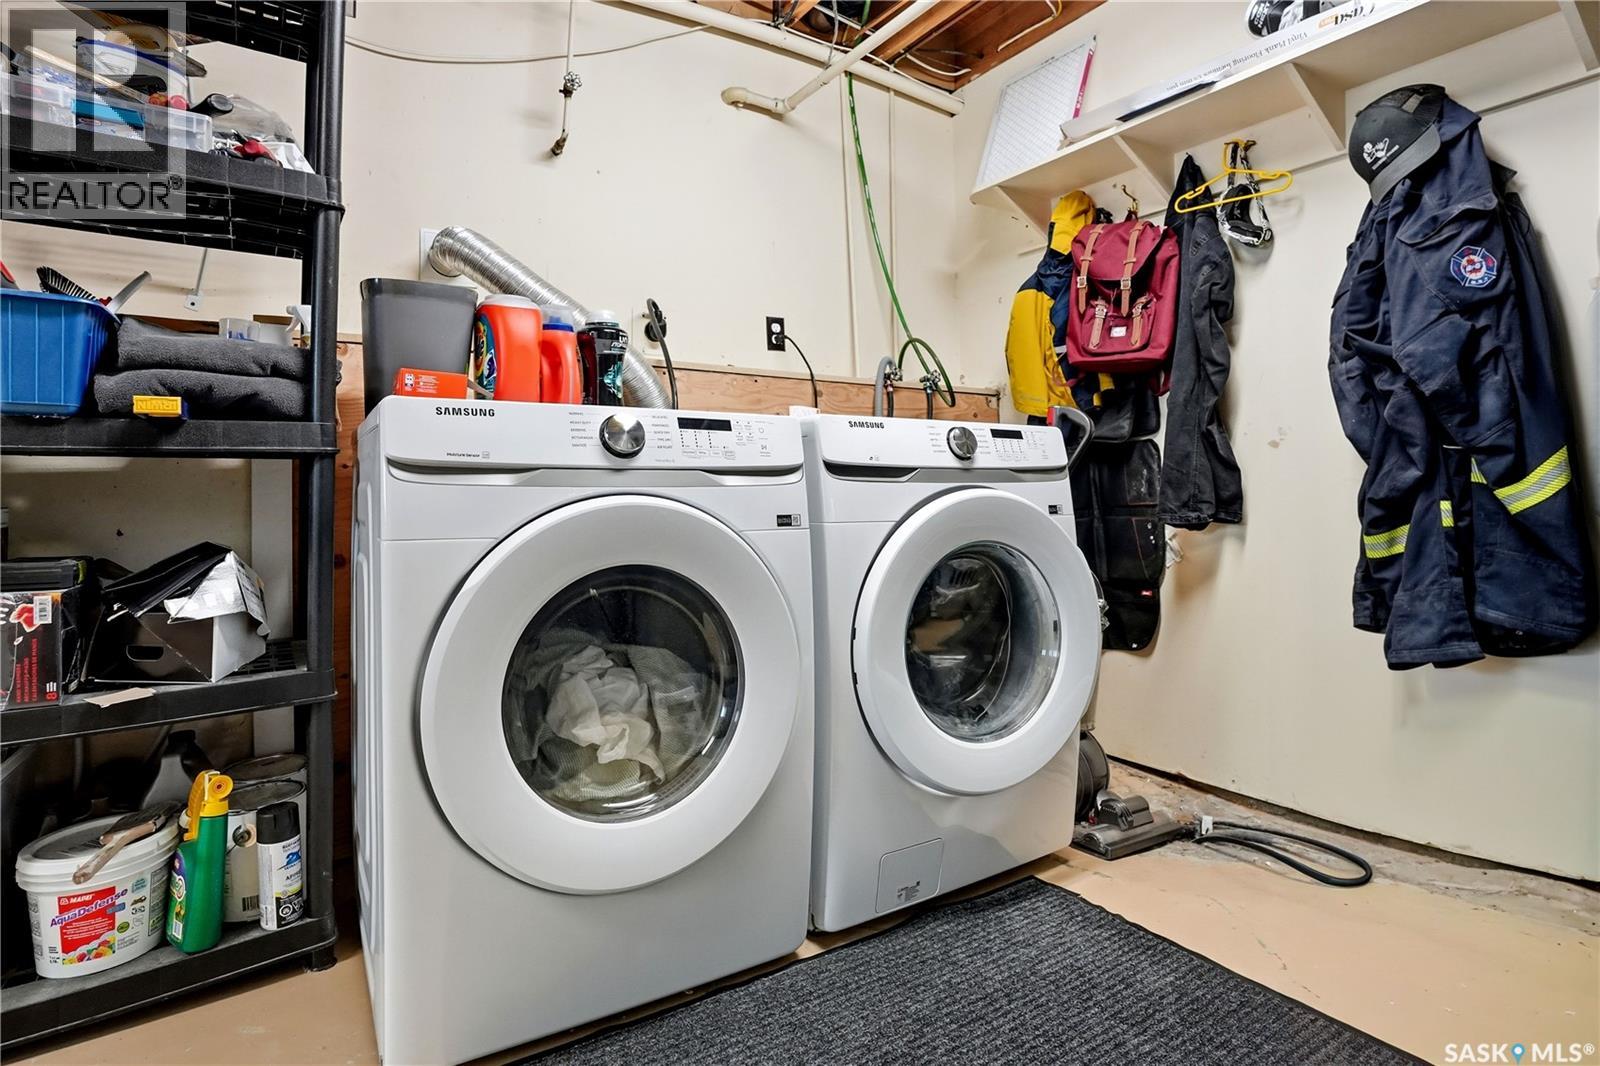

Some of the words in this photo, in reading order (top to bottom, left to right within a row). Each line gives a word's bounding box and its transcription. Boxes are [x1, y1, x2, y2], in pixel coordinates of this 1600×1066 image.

[435, 406, 495, 417] SAMSUNG
[848, 420, 885, 429] SAMSUNG
[50, 888, 128, 927] AquaDefense
